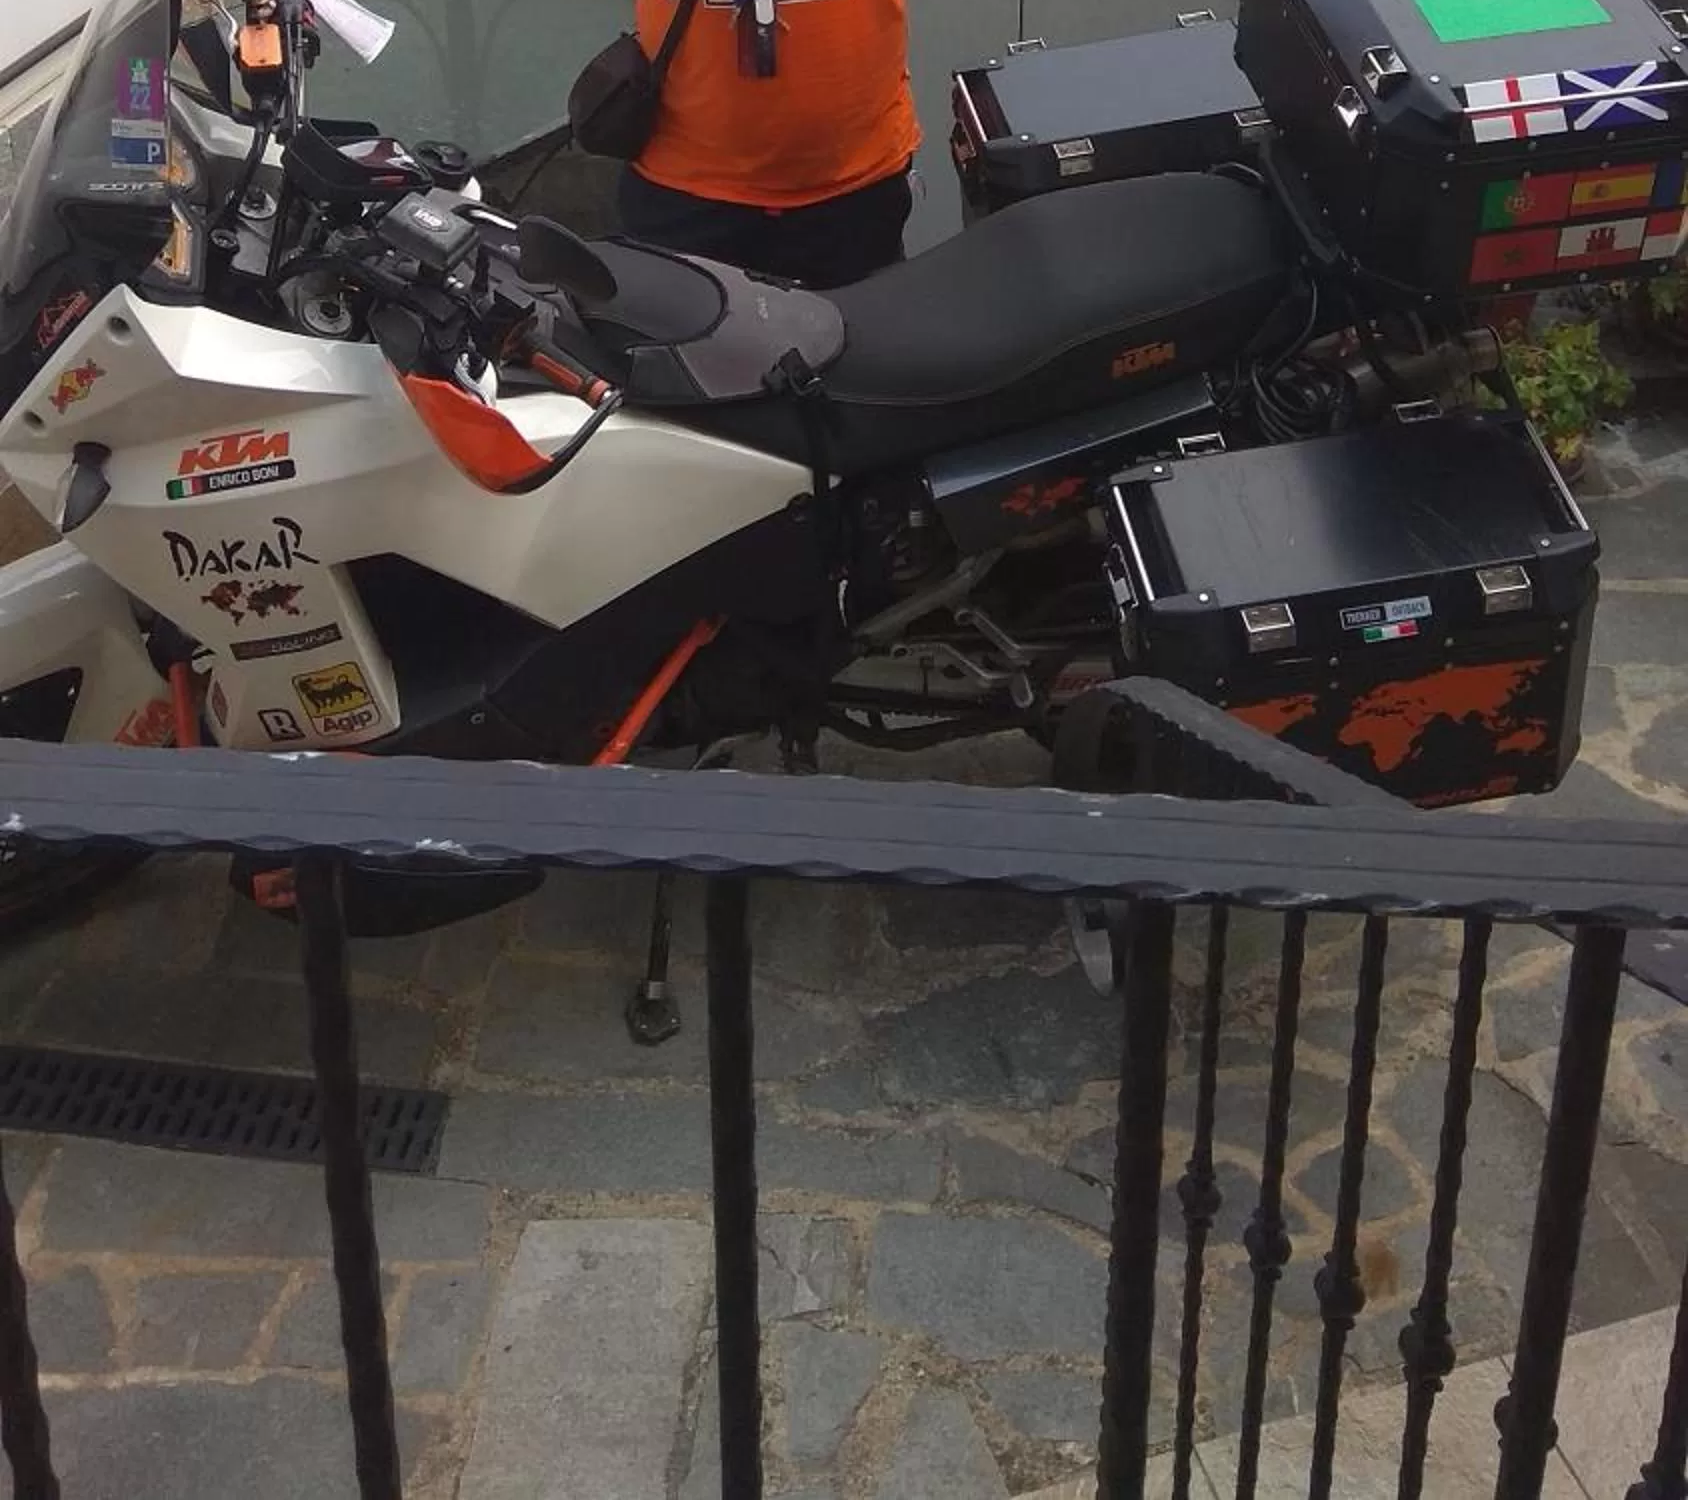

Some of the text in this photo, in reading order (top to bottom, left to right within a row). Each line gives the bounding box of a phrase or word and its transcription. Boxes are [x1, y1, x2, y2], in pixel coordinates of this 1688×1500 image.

[147, 141, 161, 163] P
[177, 428, 290, 476] KTM
[162, 515, 321, 581] DAKAR
[322, 709, 373, 734] Agip
